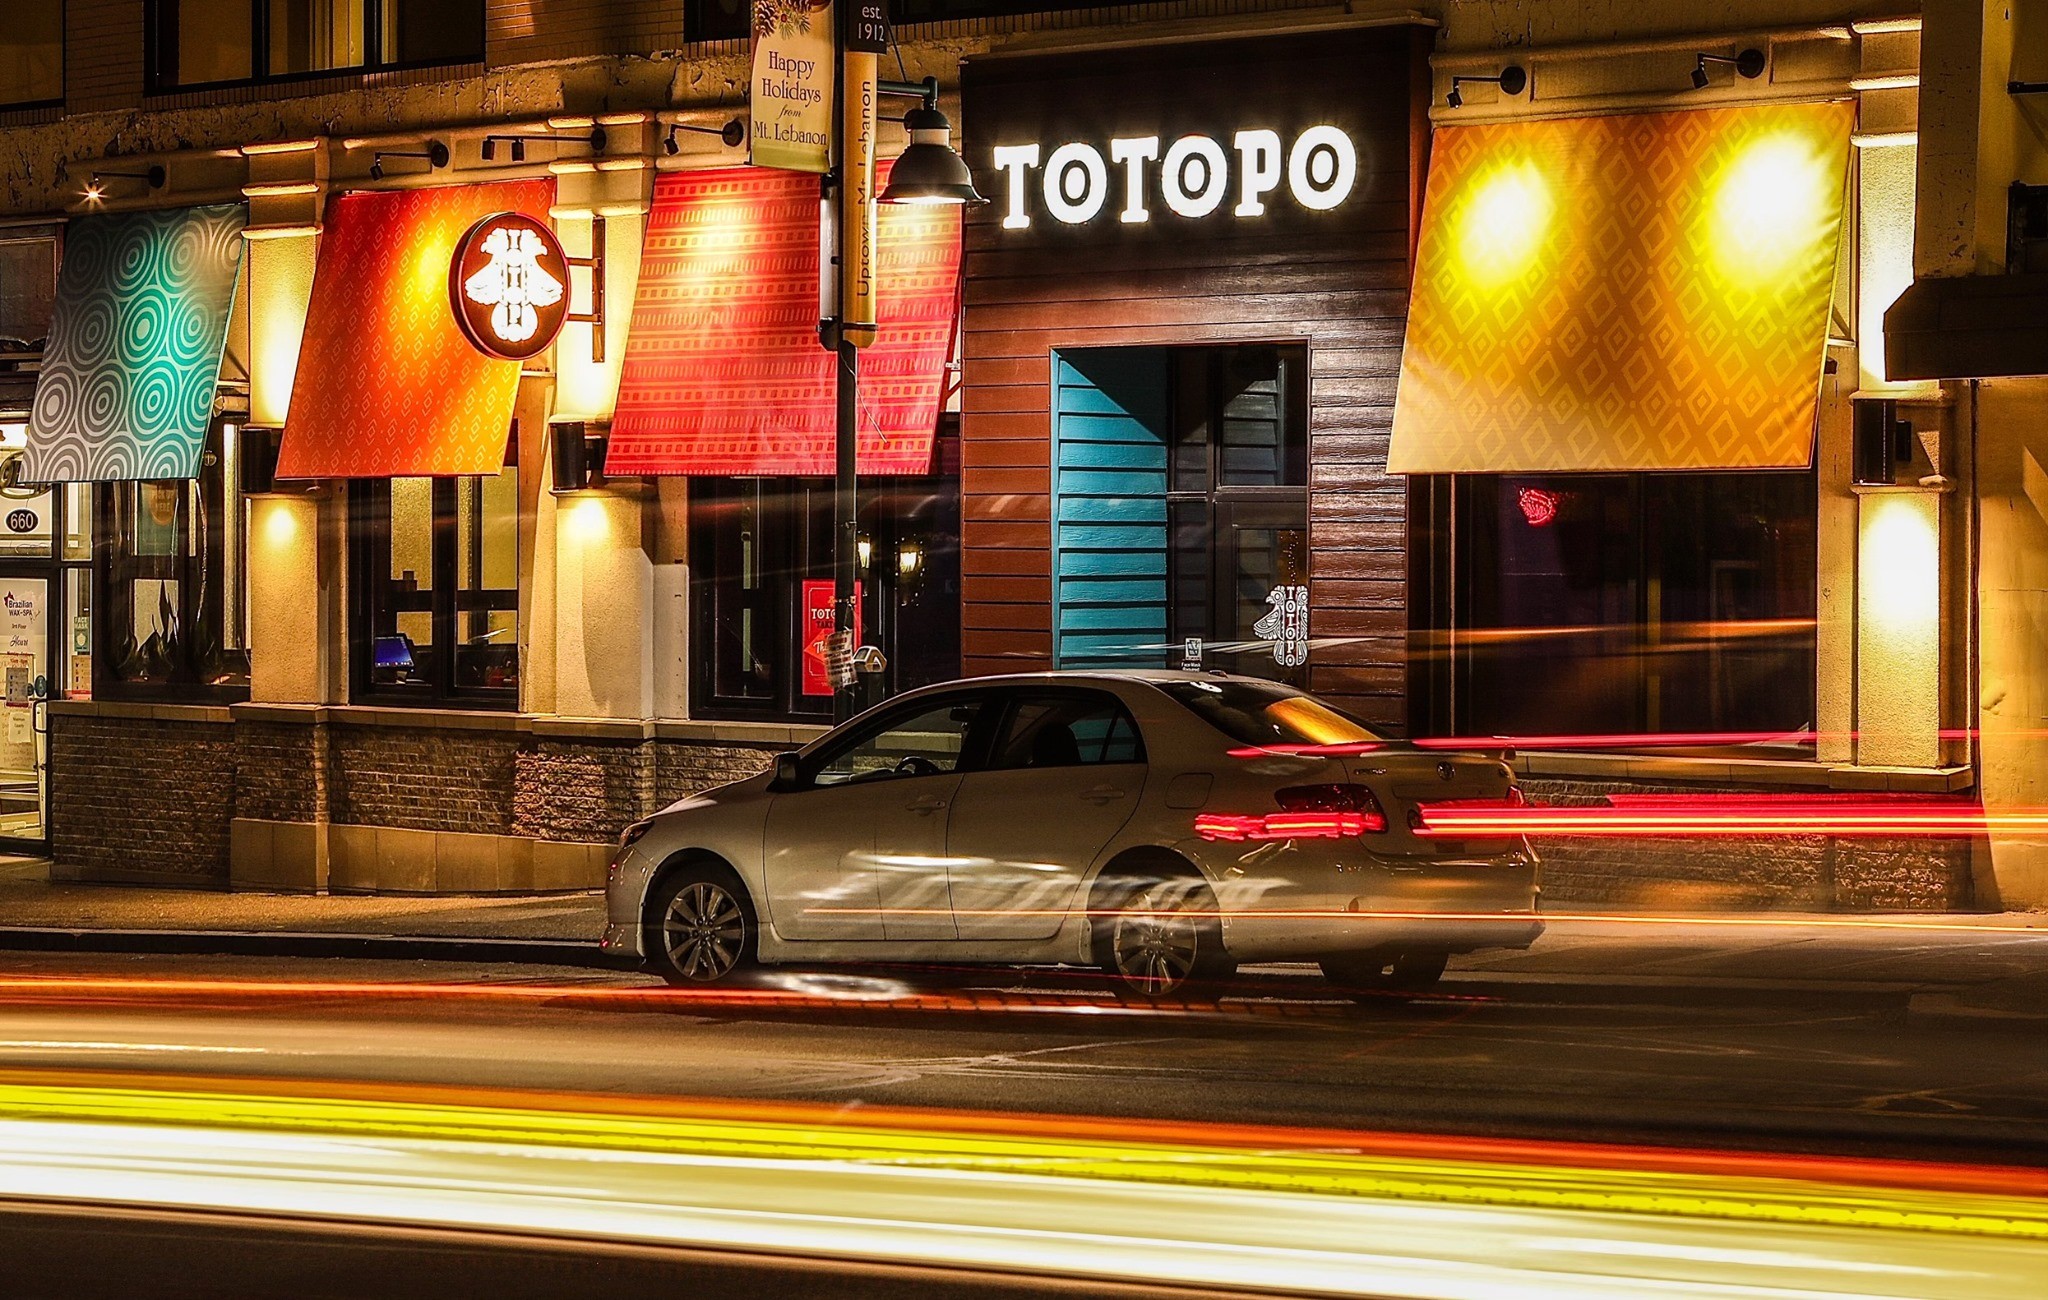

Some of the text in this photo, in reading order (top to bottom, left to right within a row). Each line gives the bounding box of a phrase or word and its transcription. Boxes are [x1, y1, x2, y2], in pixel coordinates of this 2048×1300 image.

[861, 6, 882, 20] est.
[858, 22, 885, 42] 1912
[768, 50, 816, 80] Happy
[761, 77, 822, 108] Holidays
[776, 103, 802, 120] from
[753, 120, 828, 146] Mt. Lebanon
[992, 124, 1357, 230] TOTOPO
[10, 512, 34, 530] 660
[8, 600, 33, 609] Brazilian
[9, 609, 33, 617] WAX-SPA
[1285, 585, 1297, 667] TOTOPO
